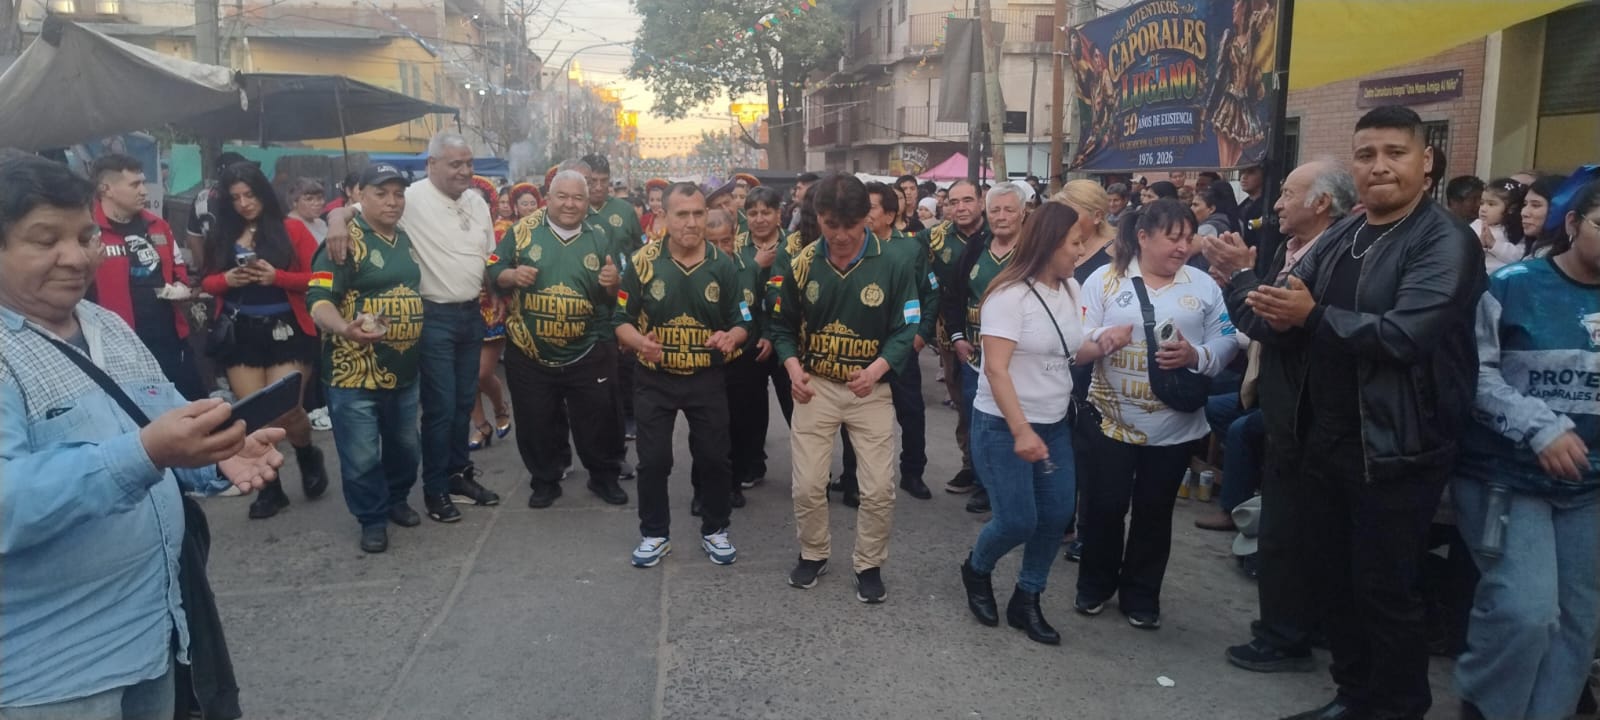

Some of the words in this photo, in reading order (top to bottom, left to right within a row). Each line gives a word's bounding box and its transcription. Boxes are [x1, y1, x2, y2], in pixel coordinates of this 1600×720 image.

[1109, 18, 1206, 81] CAPORALES
[1121, 58, 1196, 108] LUGANO
[1123, 113, 1138, 136] 50
[1138, 115, 1152, 128] AÑOS
[1153, 115, 1160, 127] DE
[1161, 112, 1193, 125] EXISTENCIA
[1139, 152, 1154, 166] 1976
[1156, 151, 1173, 165] 2026
[363, 296, 423, 316] AUTÉNTI
